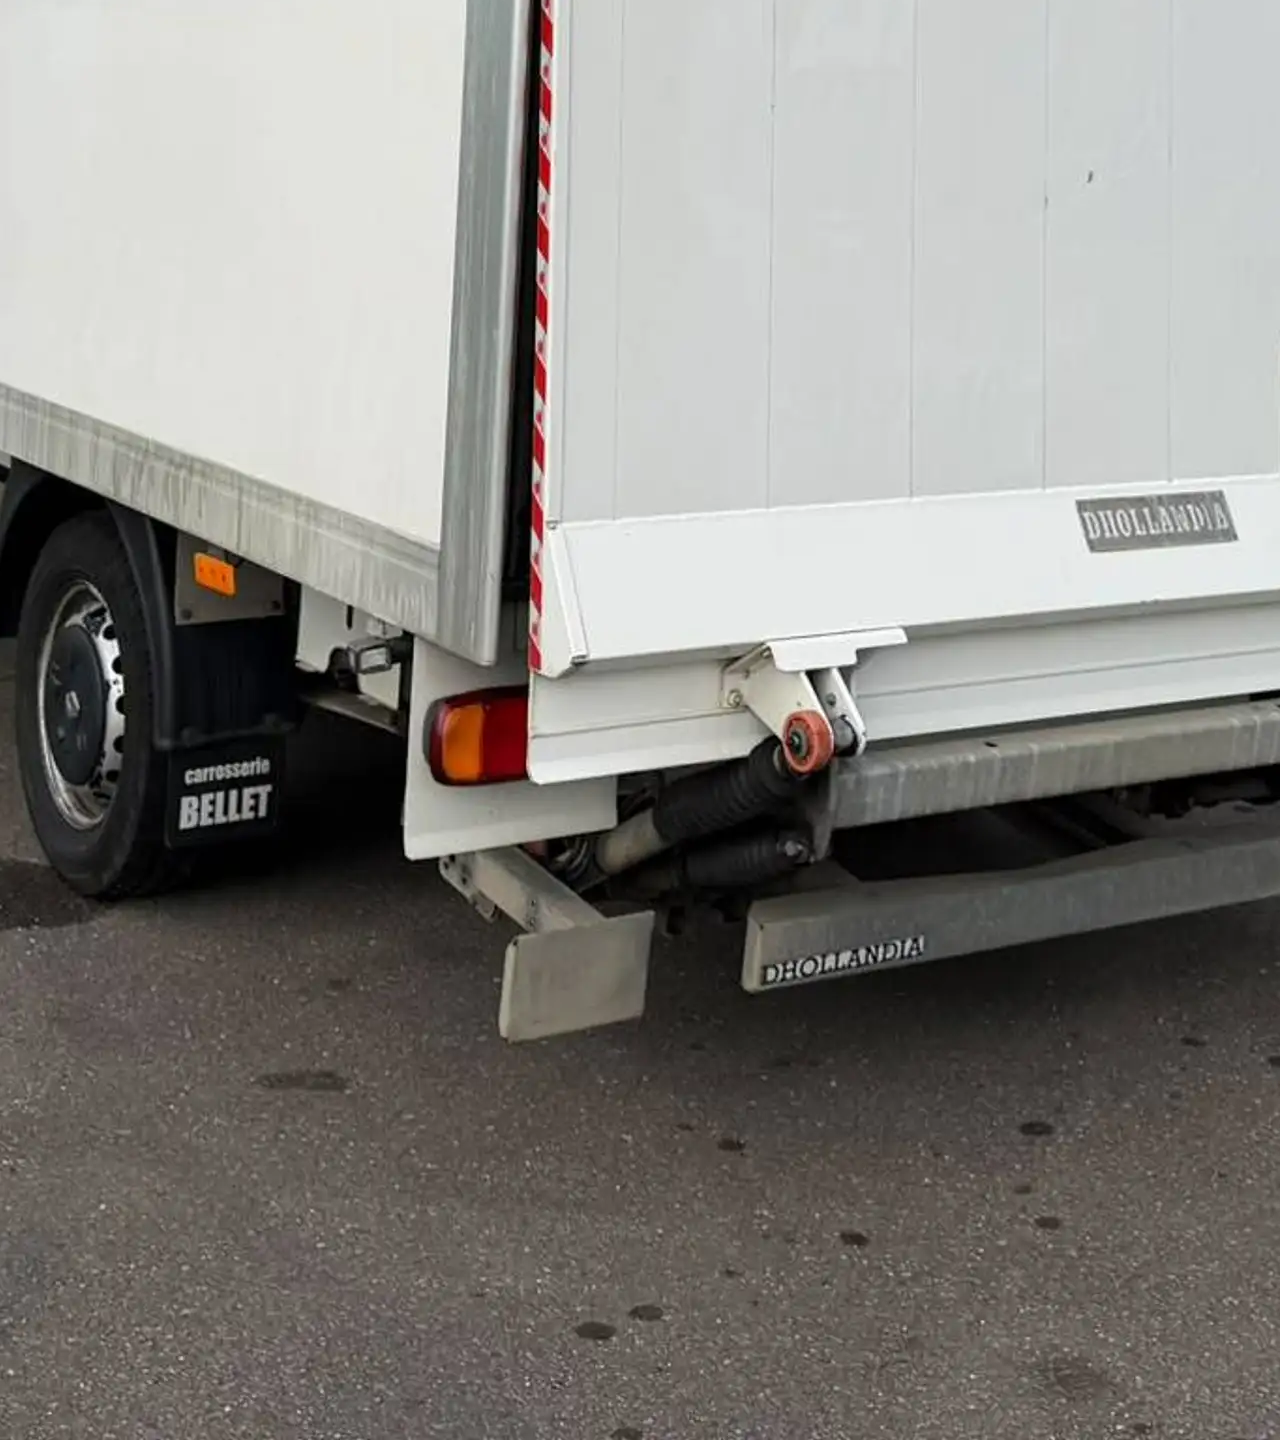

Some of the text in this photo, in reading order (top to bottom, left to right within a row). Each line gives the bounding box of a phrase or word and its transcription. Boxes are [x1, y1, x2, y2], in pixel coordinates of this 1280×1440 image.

[1083, 502, 1230, 539] DHOLLANDIA
[184, 756, 271, 785] carrosserie
[179, 784, 273, 830] BELLET
[762, 935, 925, 985] DHOLLANDIA
